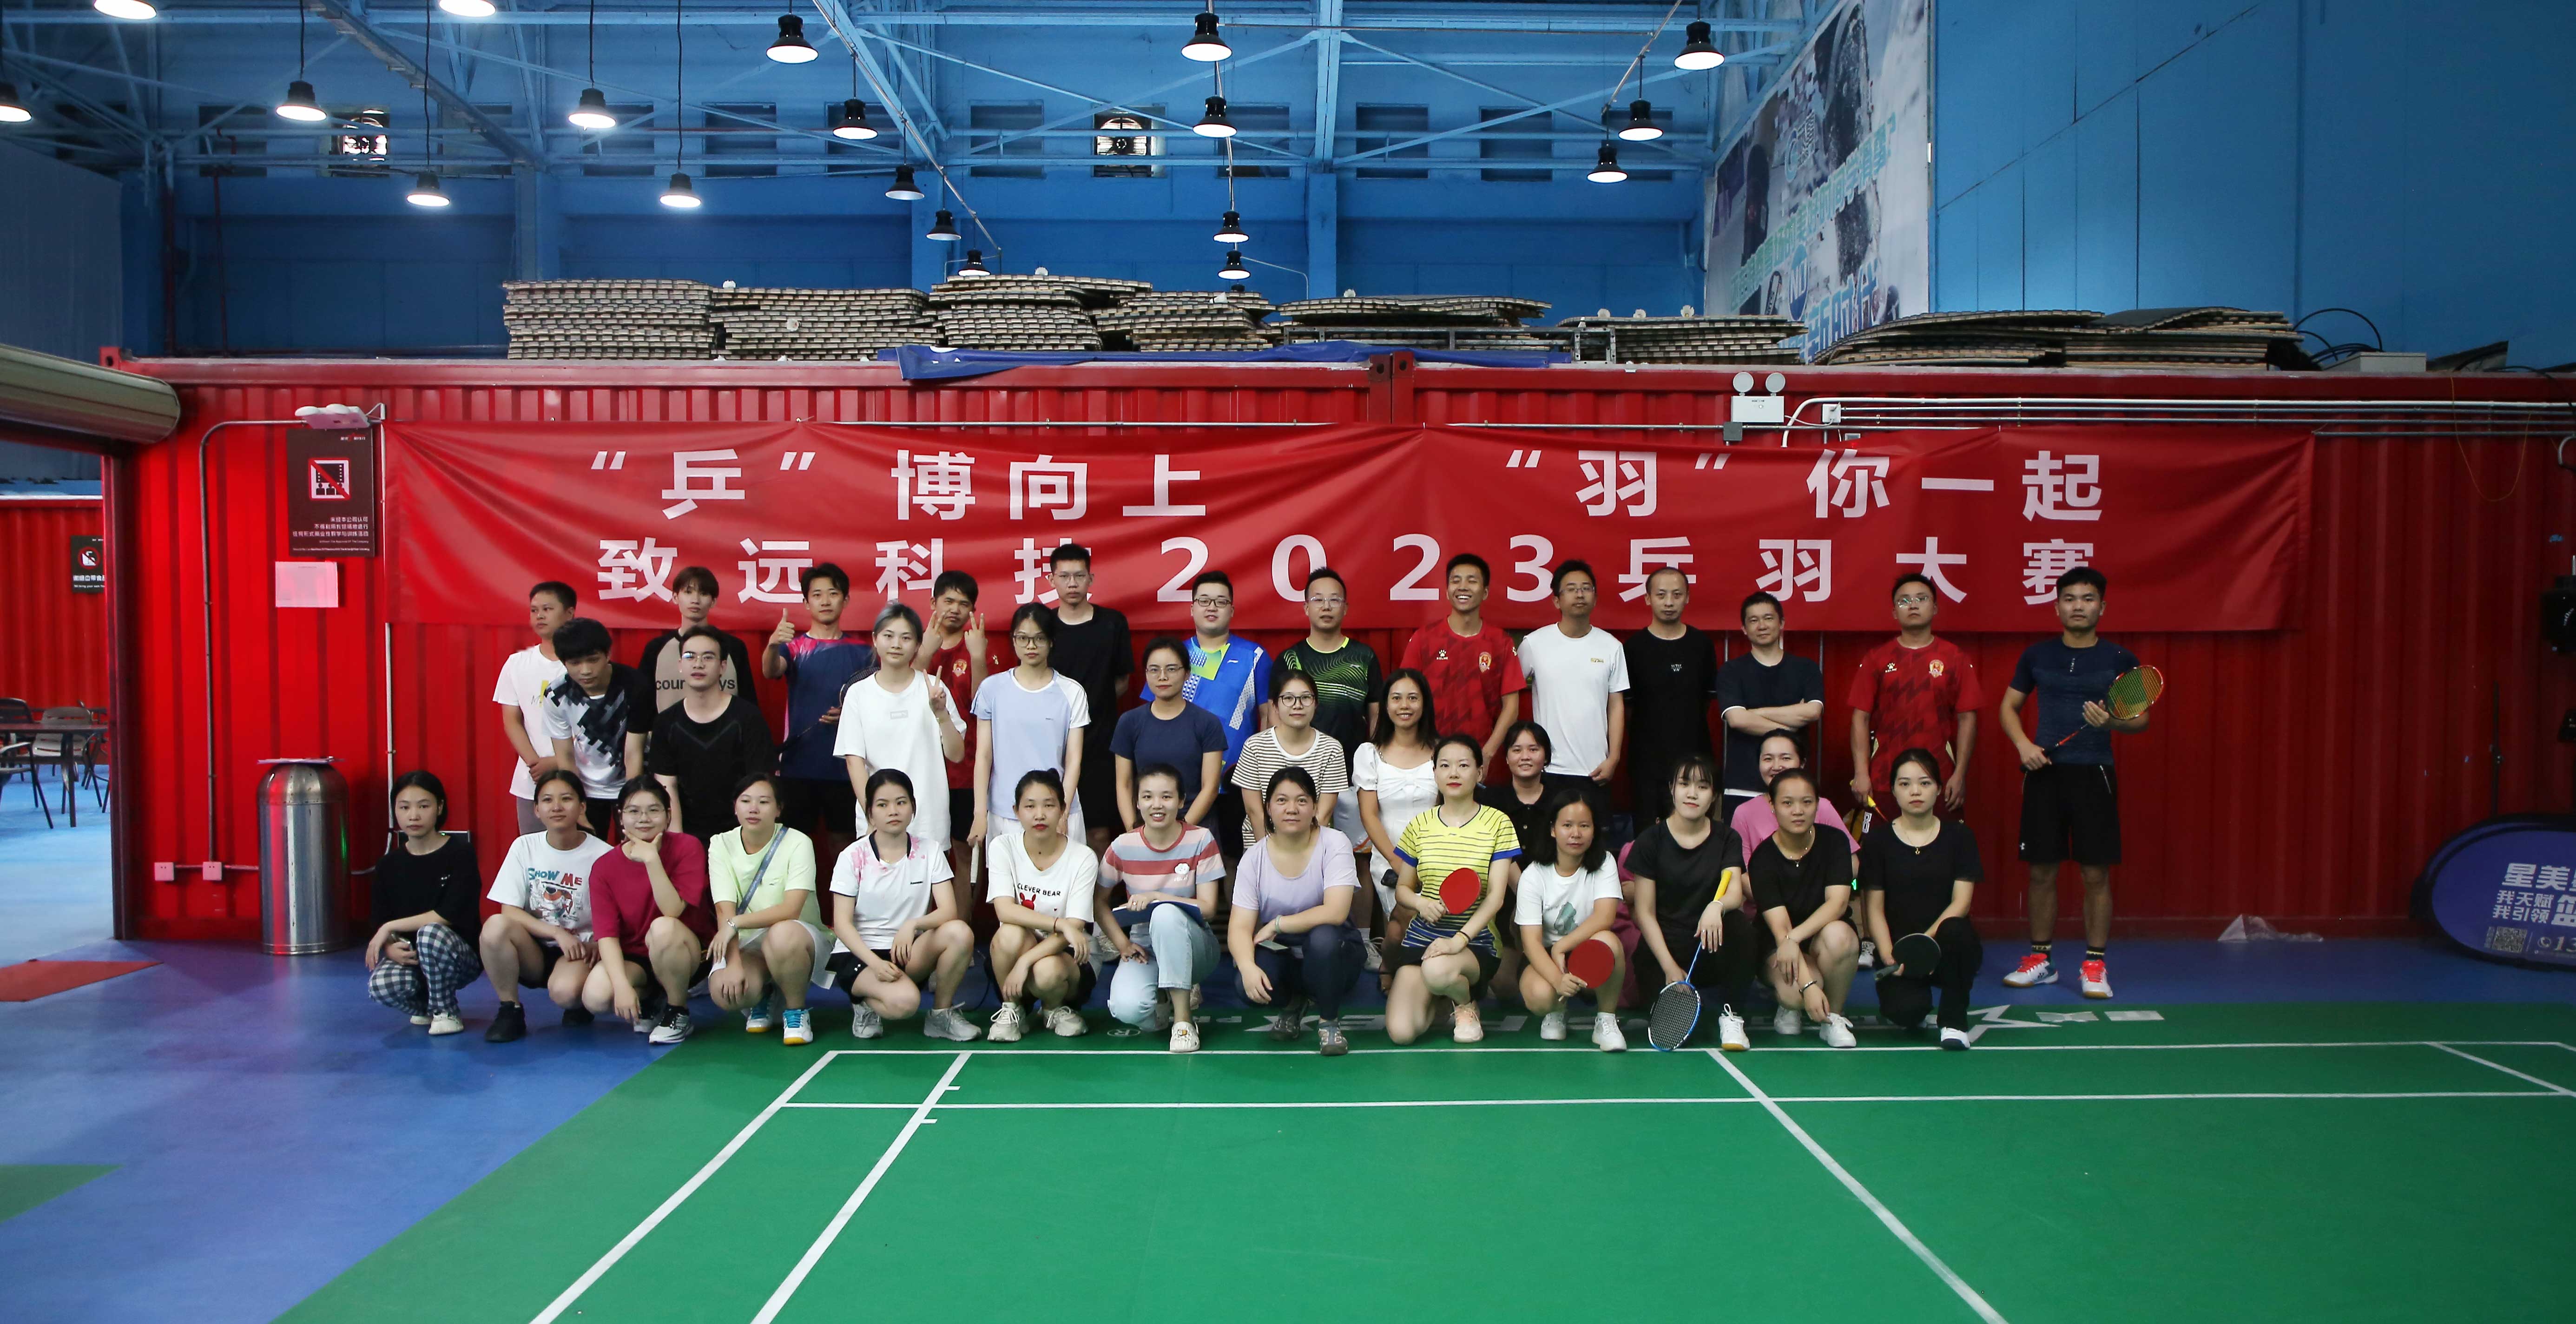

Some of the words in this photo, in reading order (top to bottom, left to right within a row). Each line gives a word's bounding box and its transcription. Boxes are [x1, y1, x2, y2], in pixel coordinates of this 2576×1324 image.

[1017, 883, 1041, 894] CLEVER
[2497, 889, 2554, 909] 我天赋
[2492, 904, 2550, 923] 我引领
